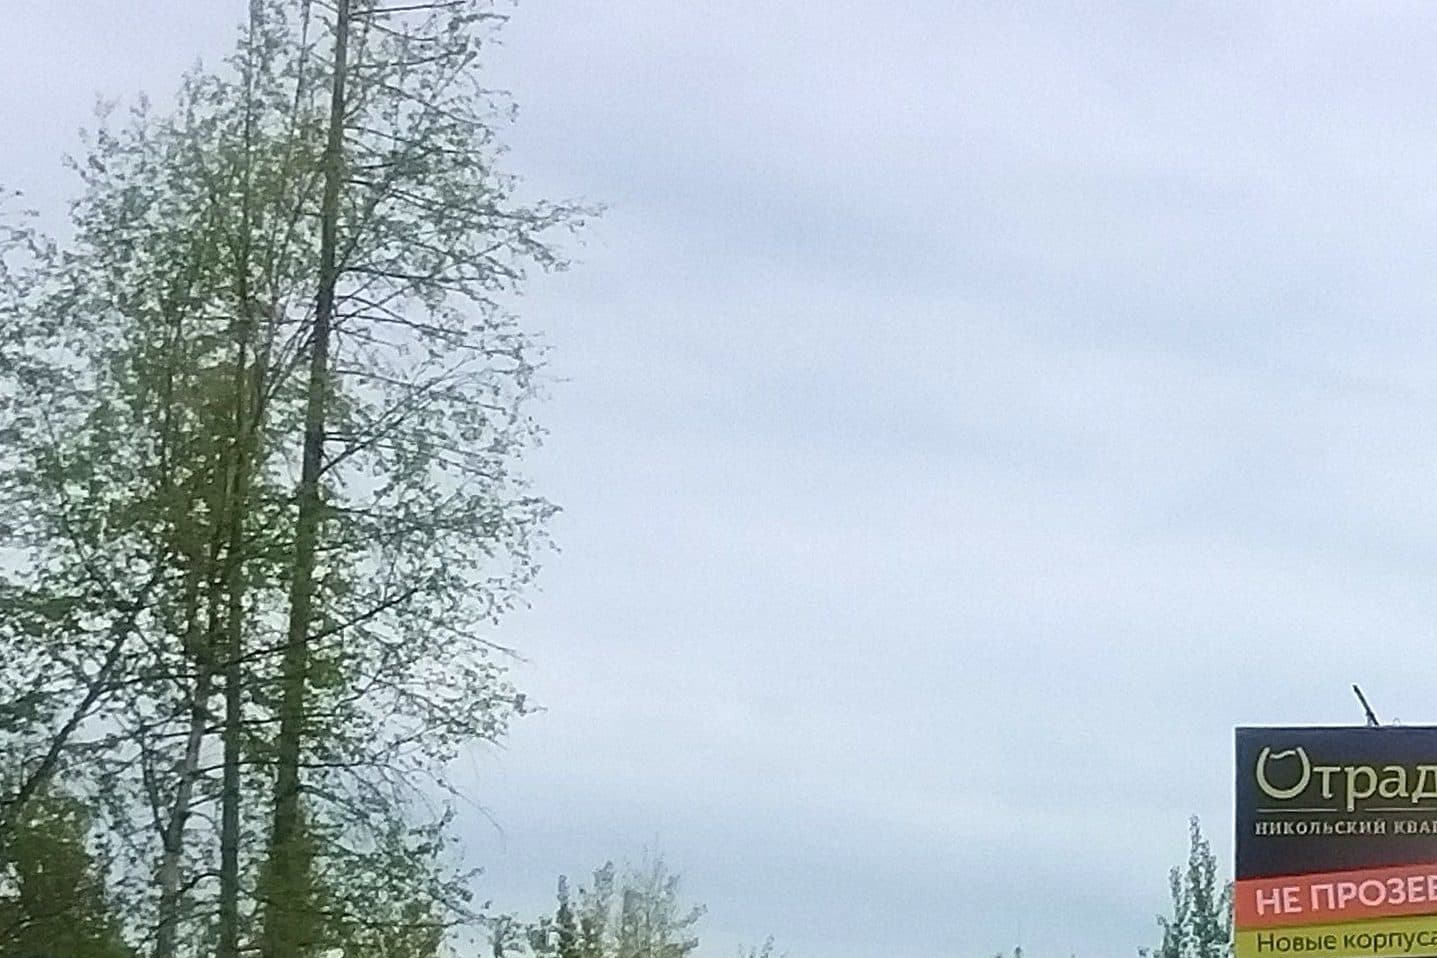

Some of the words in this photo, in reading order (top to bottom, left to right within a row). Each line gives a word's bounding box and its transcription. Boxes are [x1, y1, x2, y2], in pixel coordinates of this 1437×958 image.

[1255, 819, 1386, 836] НИКОЛЬСКИЙ
[1256, 887, 1302, 915] НЕ
[1257, 932, 1337, 953] Новые
